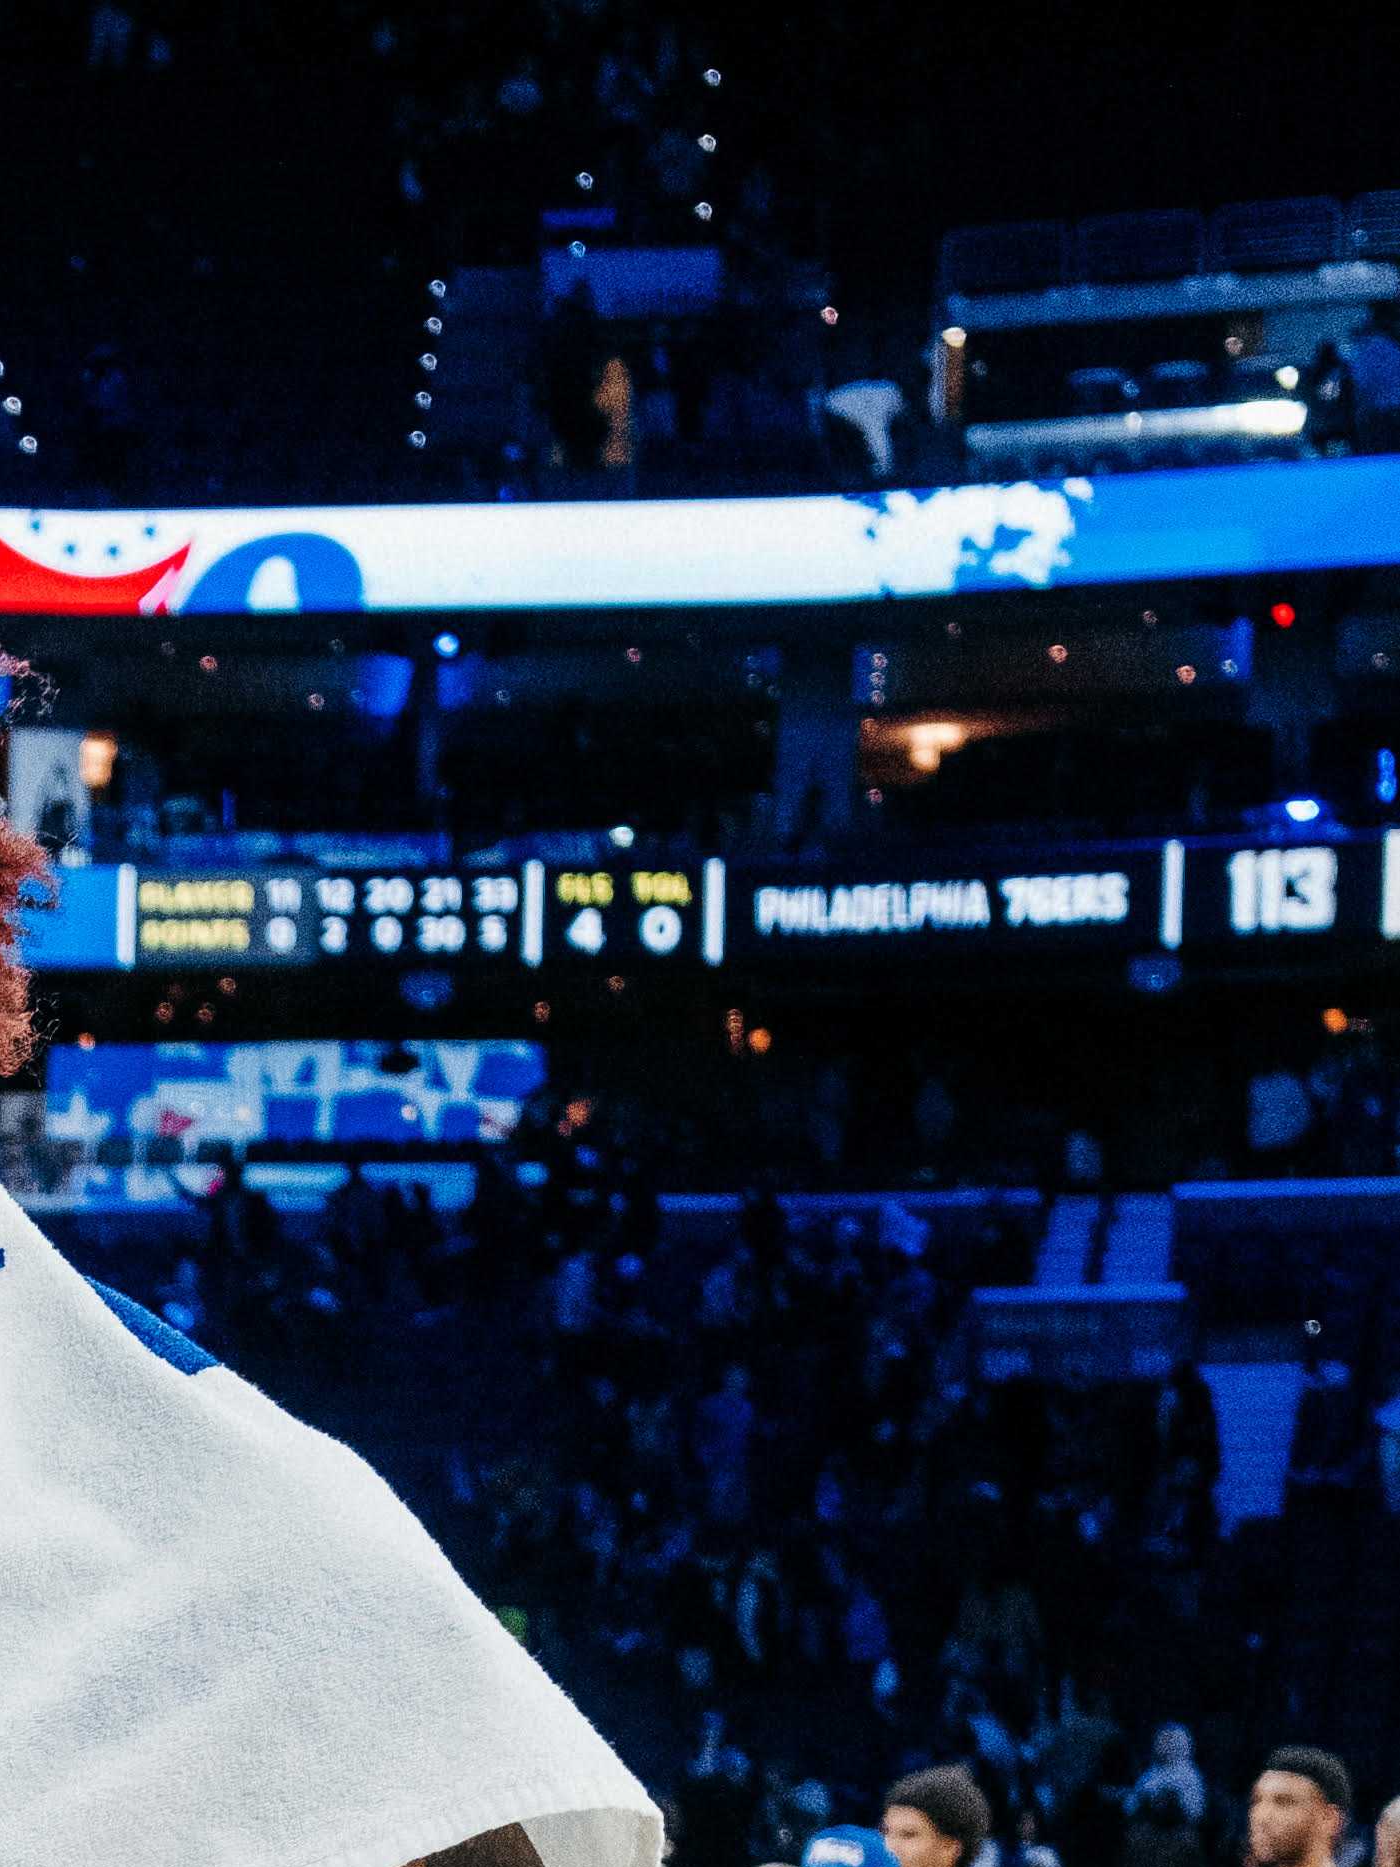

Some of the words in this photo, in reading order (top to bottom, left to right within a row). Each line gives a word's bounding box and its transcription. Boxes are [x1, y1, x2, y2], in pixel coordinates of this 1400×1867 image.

[755, 880, 990, 935] PHILADELPHIA
[1000, 871, 1129, 926] 76ERS
[1229, 847, 1337, 936] 113
[566, 907, 606, 953] 4
[639, 906, 683, 952] 0
